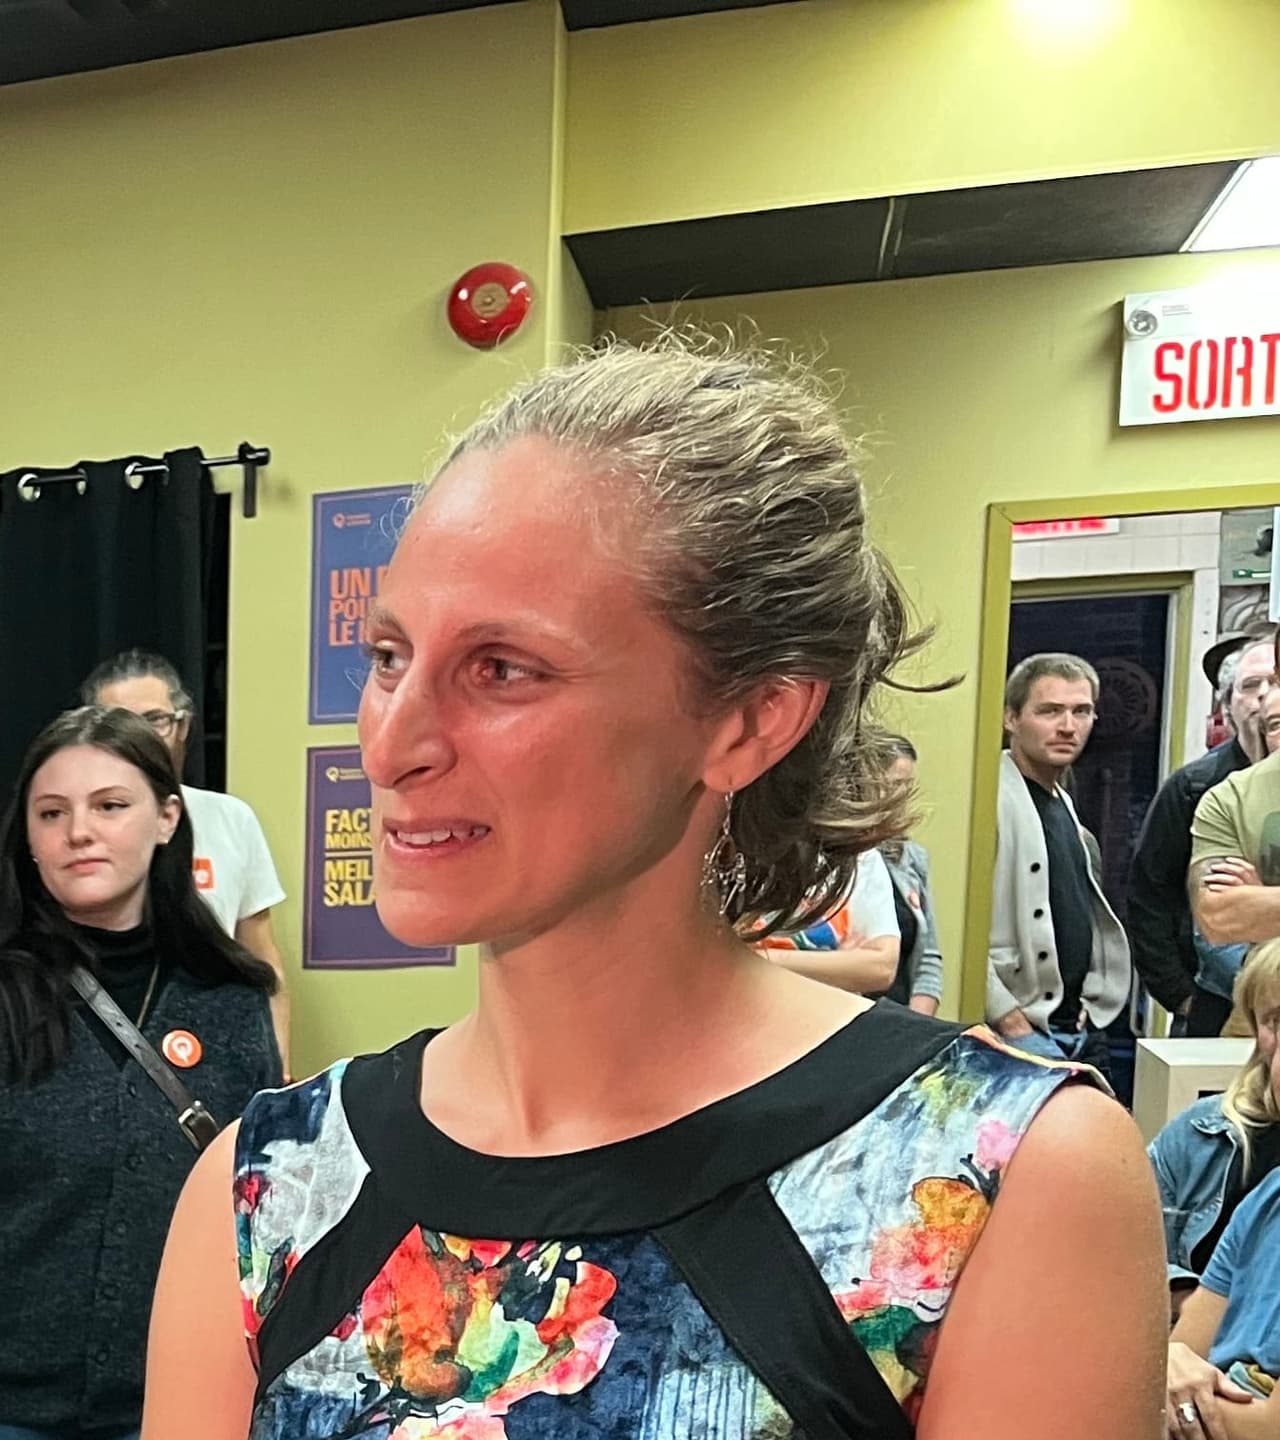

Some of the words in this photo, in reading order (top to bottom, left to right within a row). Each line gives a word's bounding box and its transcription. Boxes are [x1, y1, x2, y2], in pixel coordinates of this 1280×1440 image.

[1153, 333, 1280, 413] SORT
[330, 568, 371, 600] UN
[328, 620, 355, 646] LE
[325, 807, 372, 832] FAC
